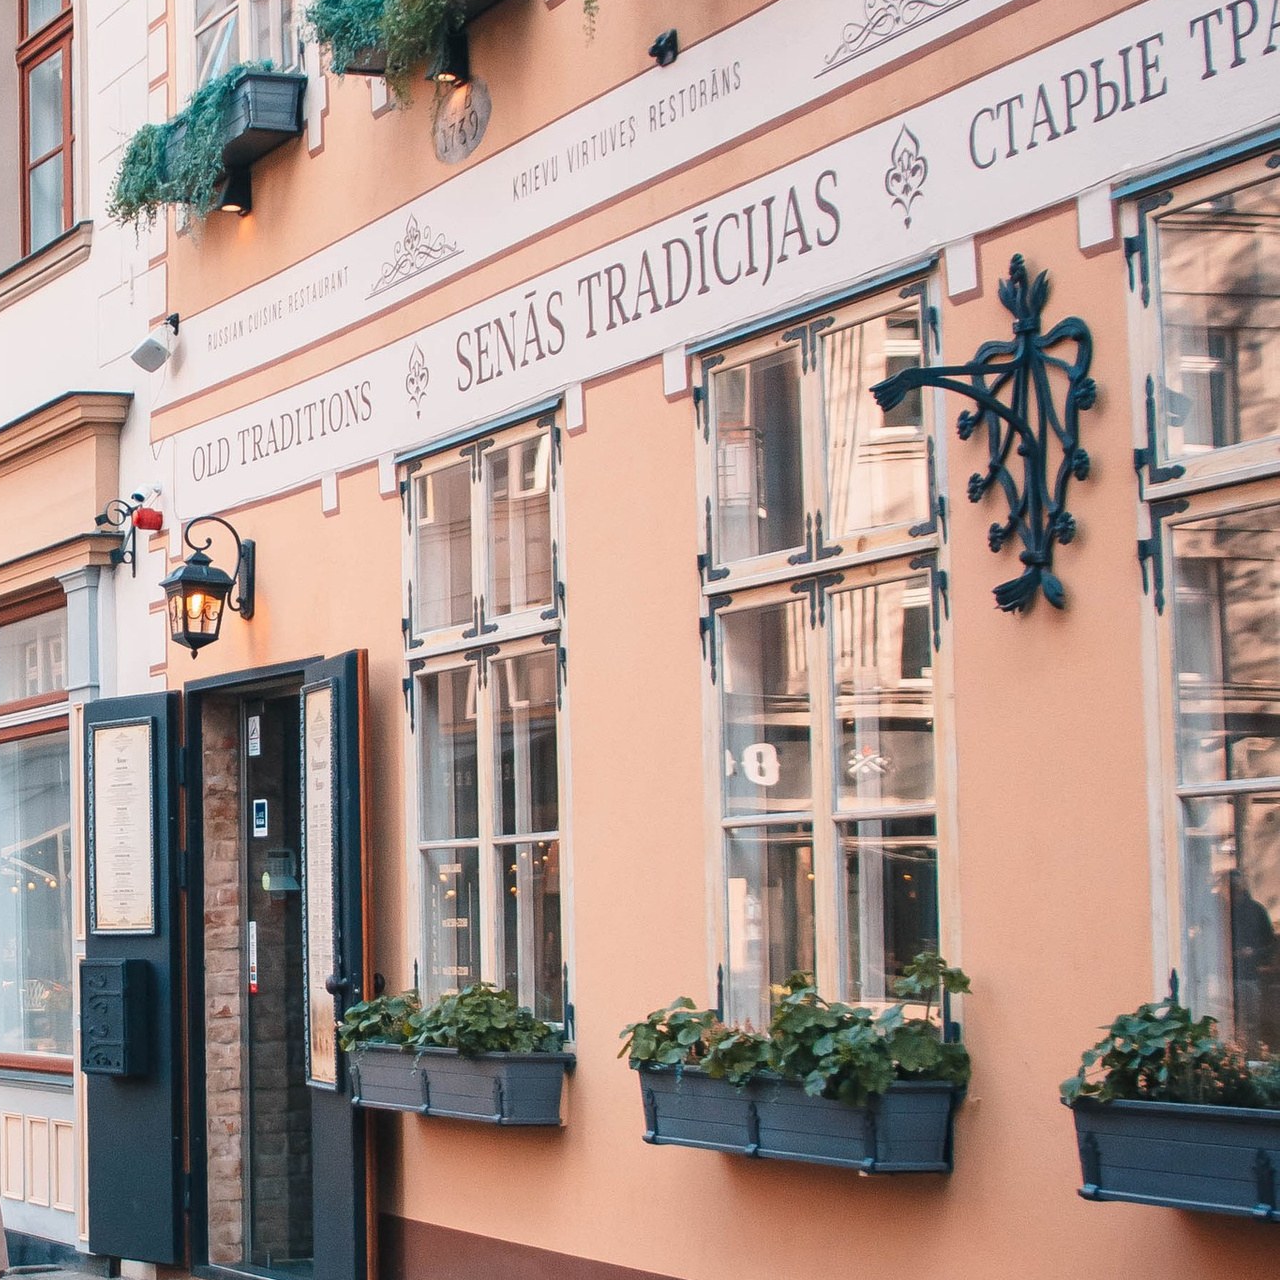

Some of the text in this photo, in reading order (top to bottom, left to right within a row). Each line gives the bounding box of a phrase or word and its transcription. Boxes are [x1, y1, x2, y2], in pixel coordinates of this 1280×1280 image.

[512, 154, 558, 203] KRIEVU
[648, 60, 742, 134] RESTORĀNS
[969, 30, 1168, 170] СТАРЫЕ
[207, 265, 349, 352] RUSSIAN CUISINE RESTAURANT
[456, 169, 841, 393] SENĀS TRADĪCIJAS
[192, 380, 372, 482] OLD TRADITIONS
